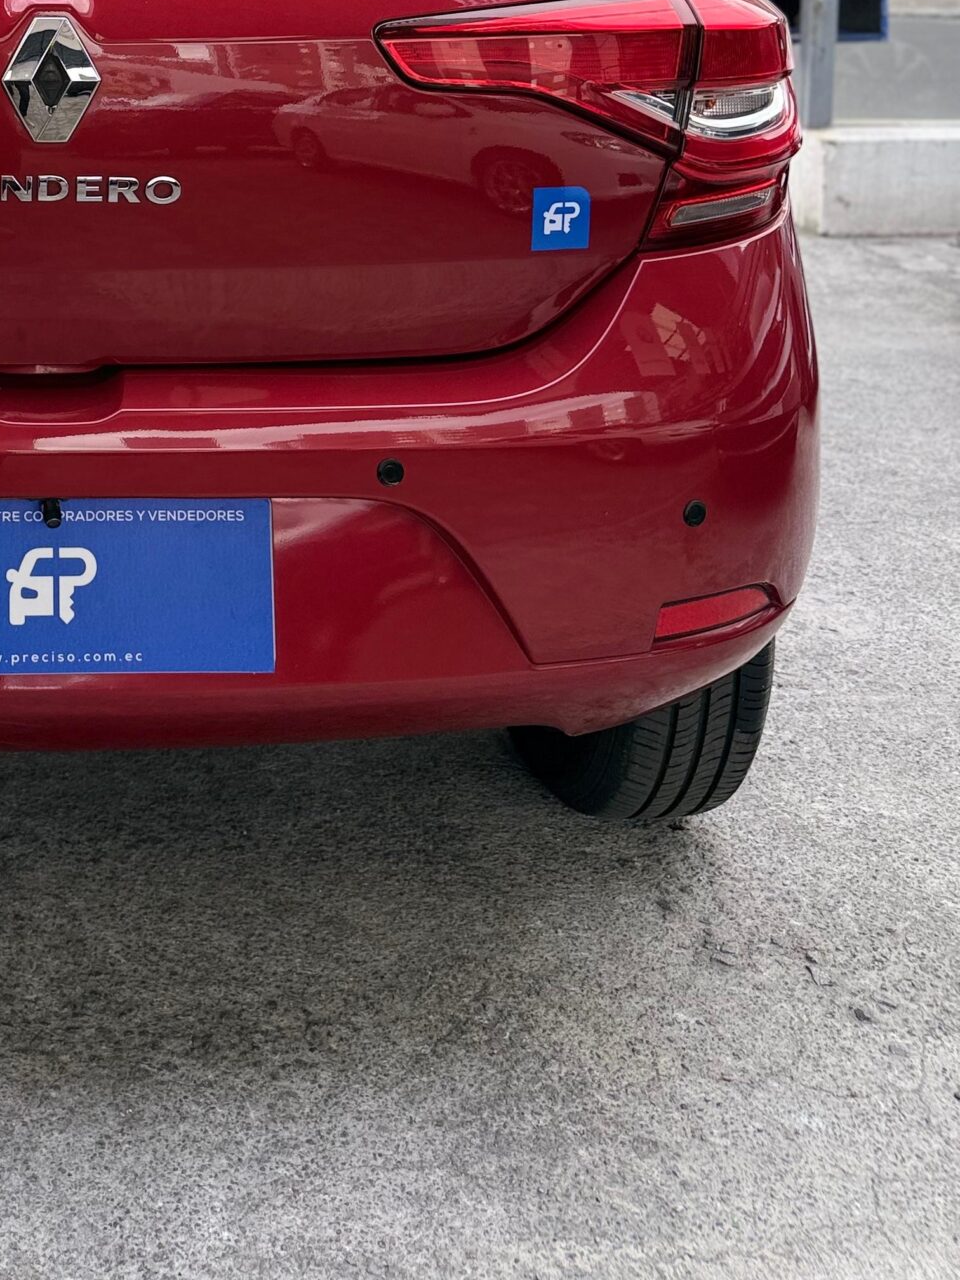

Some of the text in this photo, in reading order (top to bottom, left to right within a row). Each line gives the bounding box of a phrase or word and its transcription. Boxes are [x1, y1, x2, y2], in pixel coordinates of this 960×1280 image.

[23, 510, 134, 522] CORADORES
[136, 510, 146, 521] Y
[147, 509, 245, 522] VENDEDORES
